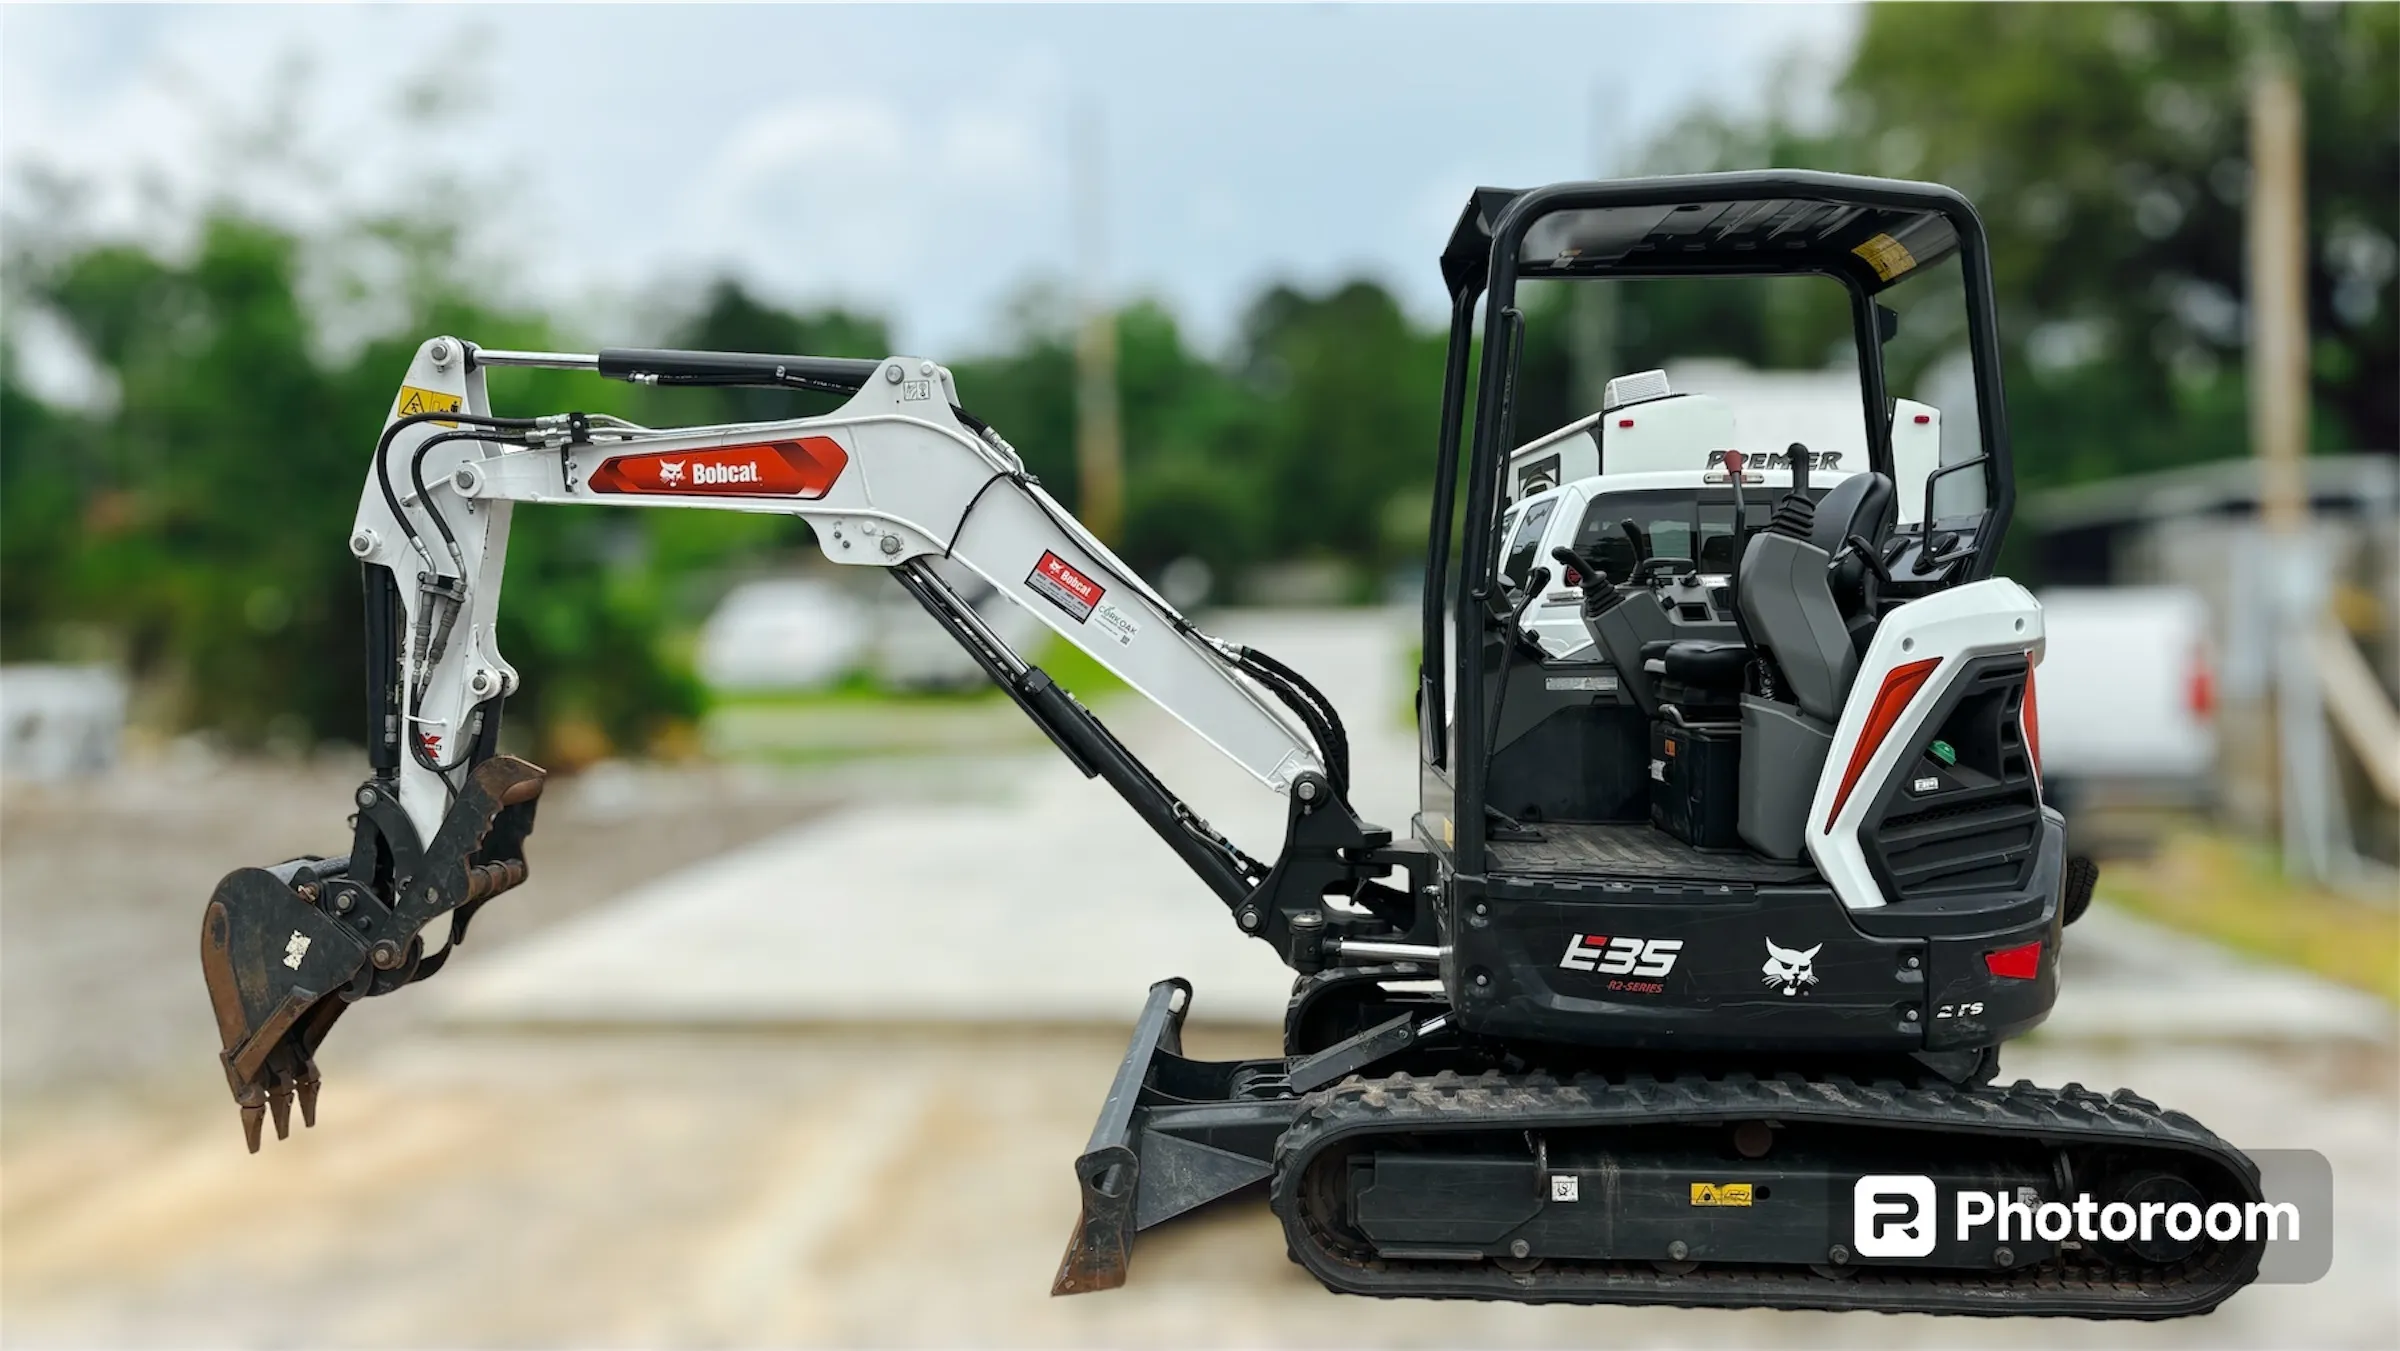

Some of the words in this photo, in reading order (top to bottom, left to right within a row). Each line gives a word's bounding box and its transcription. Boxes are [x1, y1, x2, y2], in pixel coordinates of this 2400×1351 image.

[692, 461, 758, 485] Bobcat
[1060, 570, 1093, 597] Bobcat
[1560, 933, 1684, 978] E35
[1607, 980, 1664, 994] R2-SERIES
